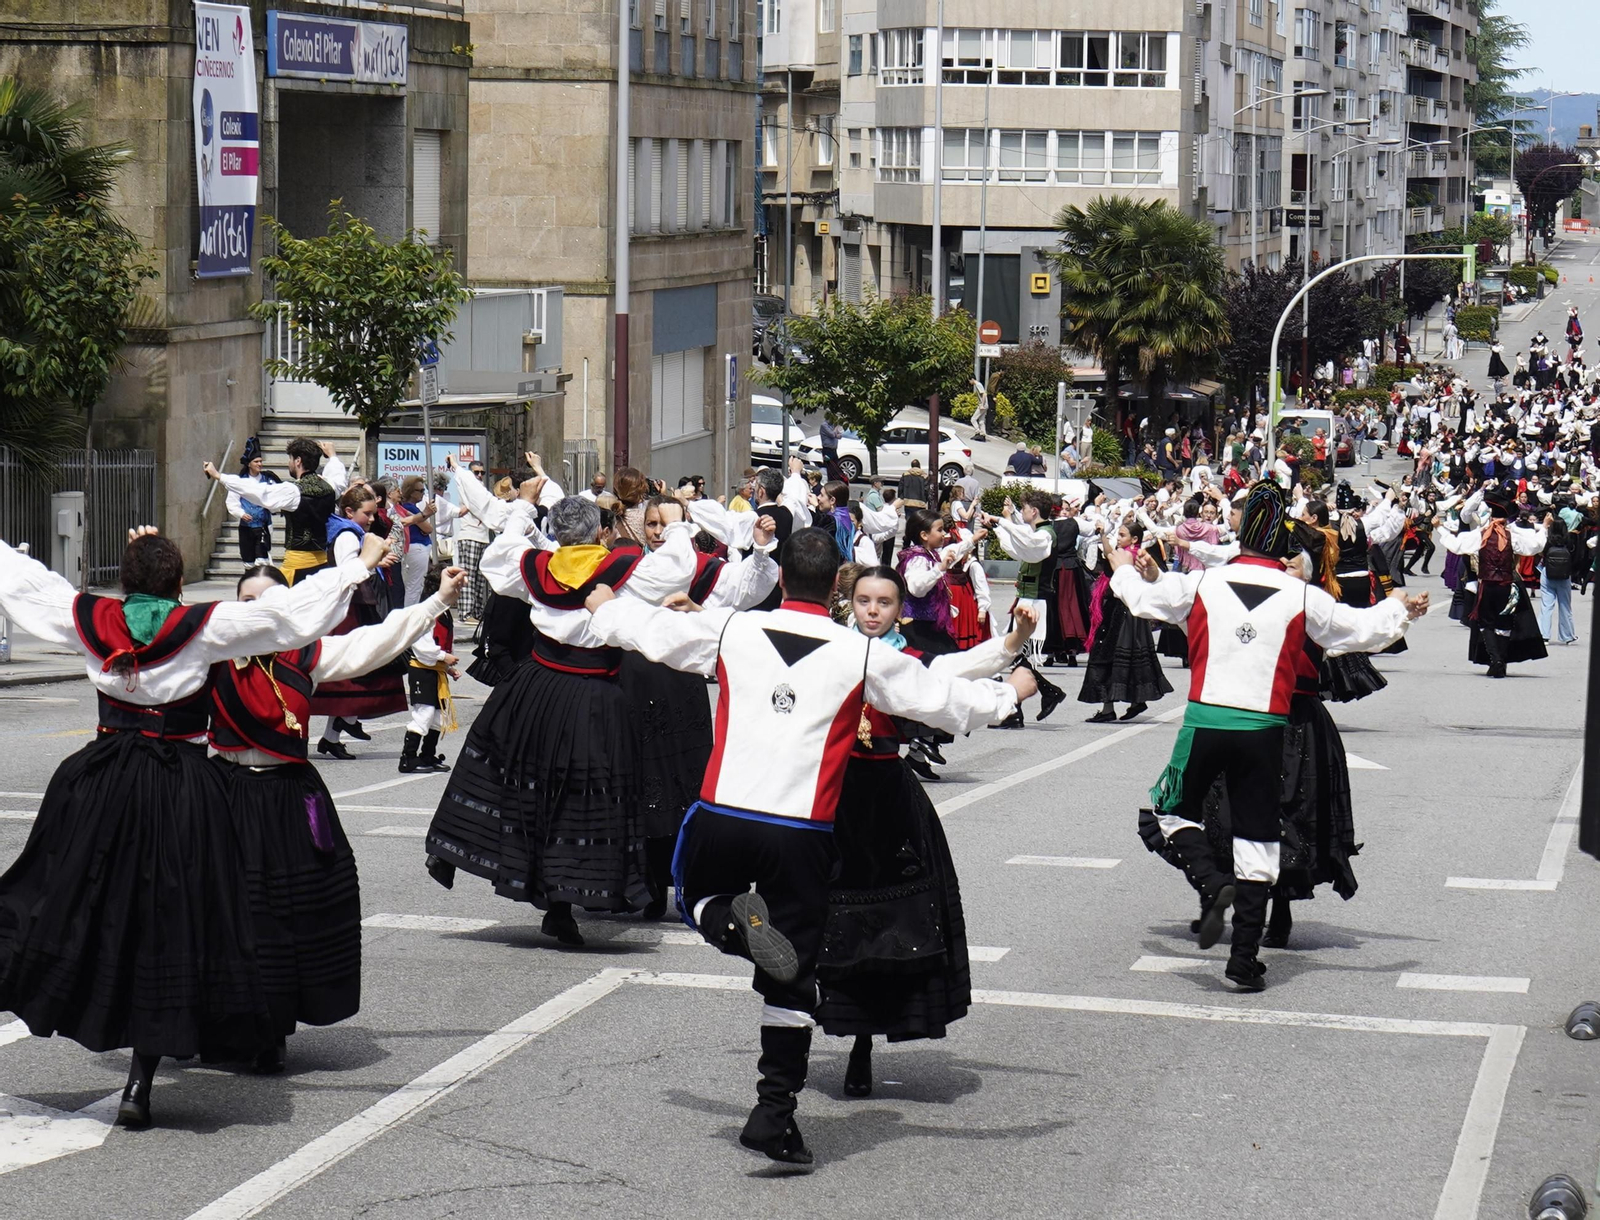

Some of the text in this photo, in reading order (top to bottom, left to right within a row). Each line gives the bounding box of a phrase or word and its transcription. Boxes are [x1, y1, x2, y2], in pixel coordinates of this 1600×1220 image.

[197, 16, 220, 52] VEN
[283, 28, 343, 64] Colexio El Pilar
[364, 30, 406, 78] maristas
[222, 152, 242, 171] El Pilar
[384, 448, 420, 461] ISDIN
[384, 464, 435, 472] FusionWatr
